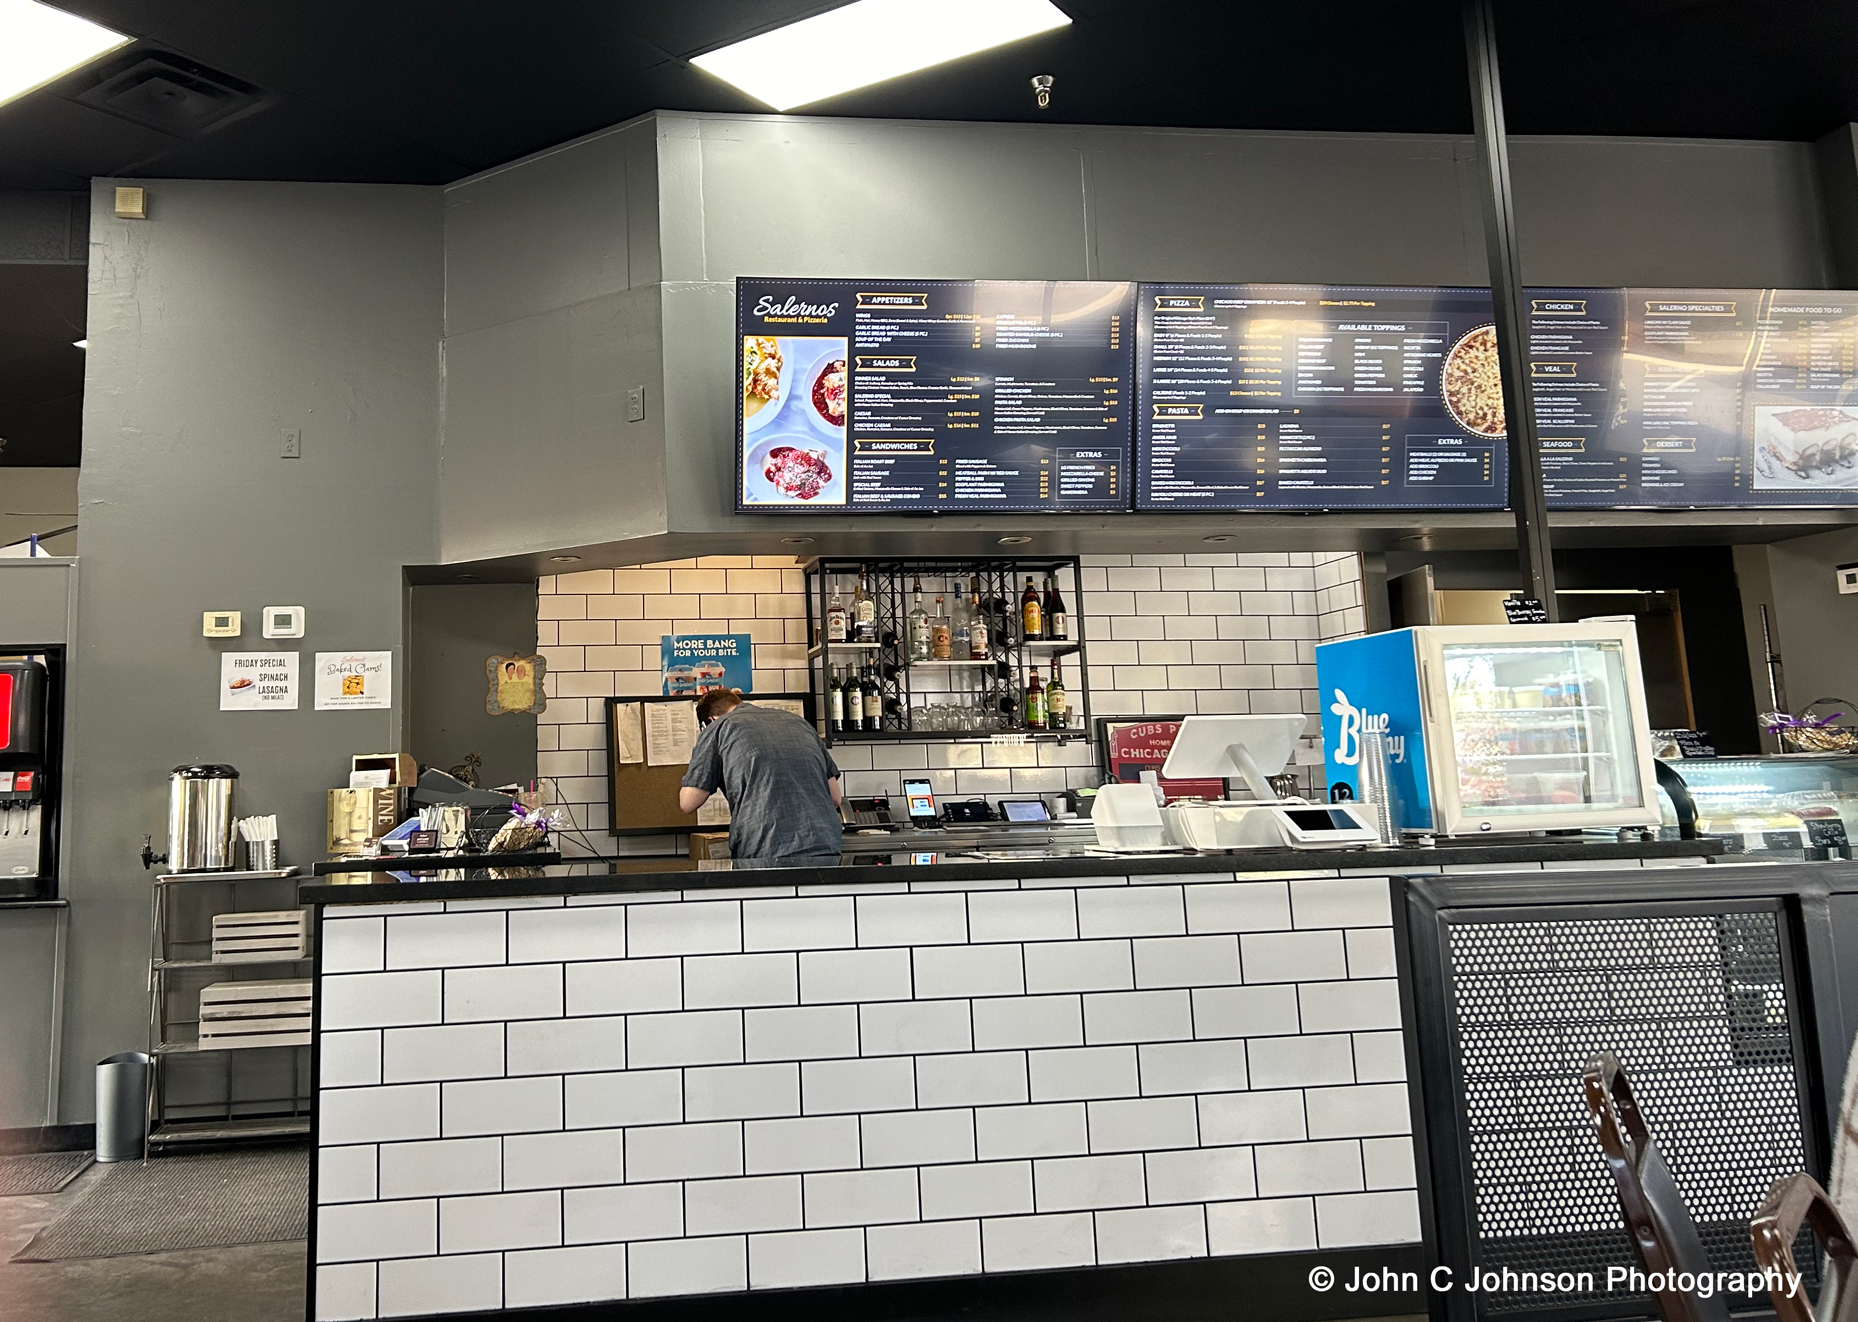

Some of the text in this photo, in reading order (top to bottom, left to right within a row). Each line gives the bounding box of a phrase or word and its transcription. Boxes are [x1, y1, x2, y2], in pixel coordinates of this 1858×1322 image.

[753, 296, 838, 317] Salernos
[674, 640, 736, 649] MORE BANG
[235, 659, 286, 667] FRIDAY SPECIAL
[327, 663, 382, 675] Baked Clams!
[259, 673, 288, 681] SPINACH
[258, 686, 288, 694] LASAGNA
[1130, 724, 1162, 738] CUBS
[1121, 747, 1169, 758] CHICAG
[378, 788, 394, 825] WINE
